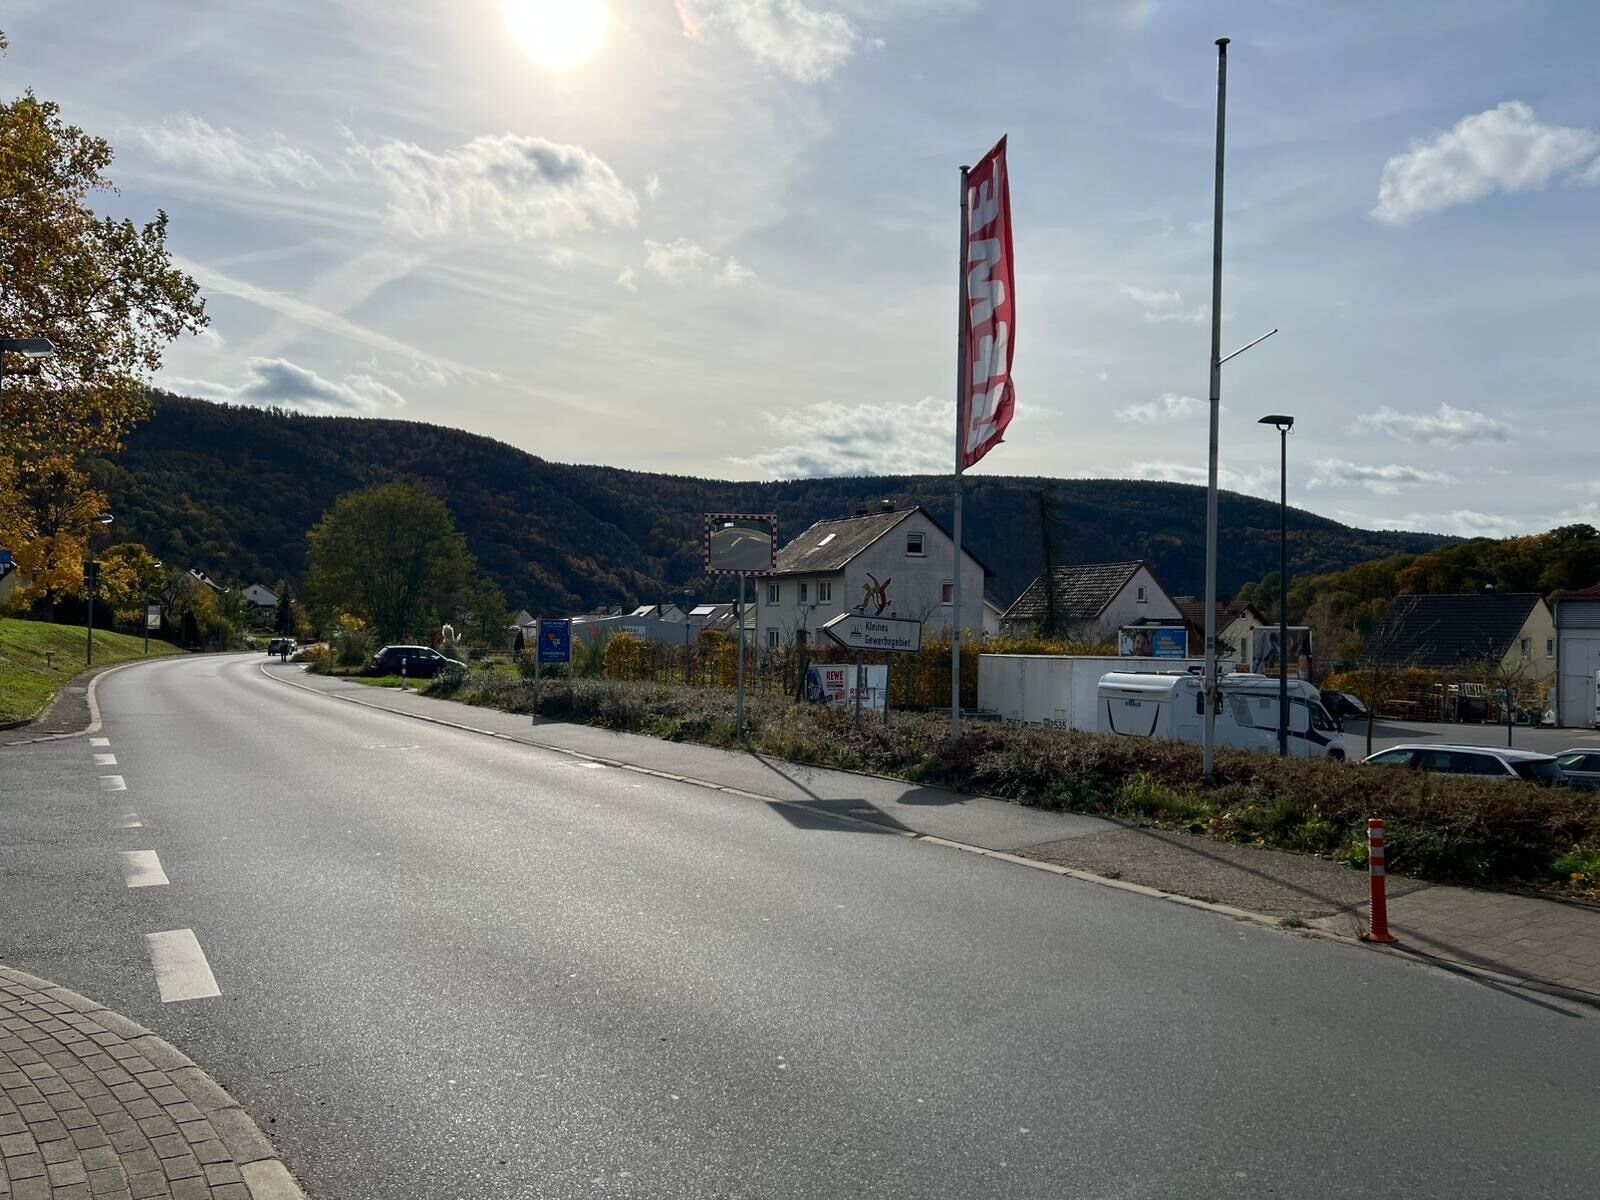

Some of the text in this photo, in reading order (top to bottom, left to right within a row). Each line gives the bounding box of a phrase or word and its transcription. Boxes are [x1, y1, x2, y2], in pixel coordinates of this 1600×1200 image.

[966, 158, 1007, 454] REWE
[865, 621, 889, 632] Kleines
[864, 634, 911, 648] Gewerbegebiet
[826, 670, 844, 680] REWE
